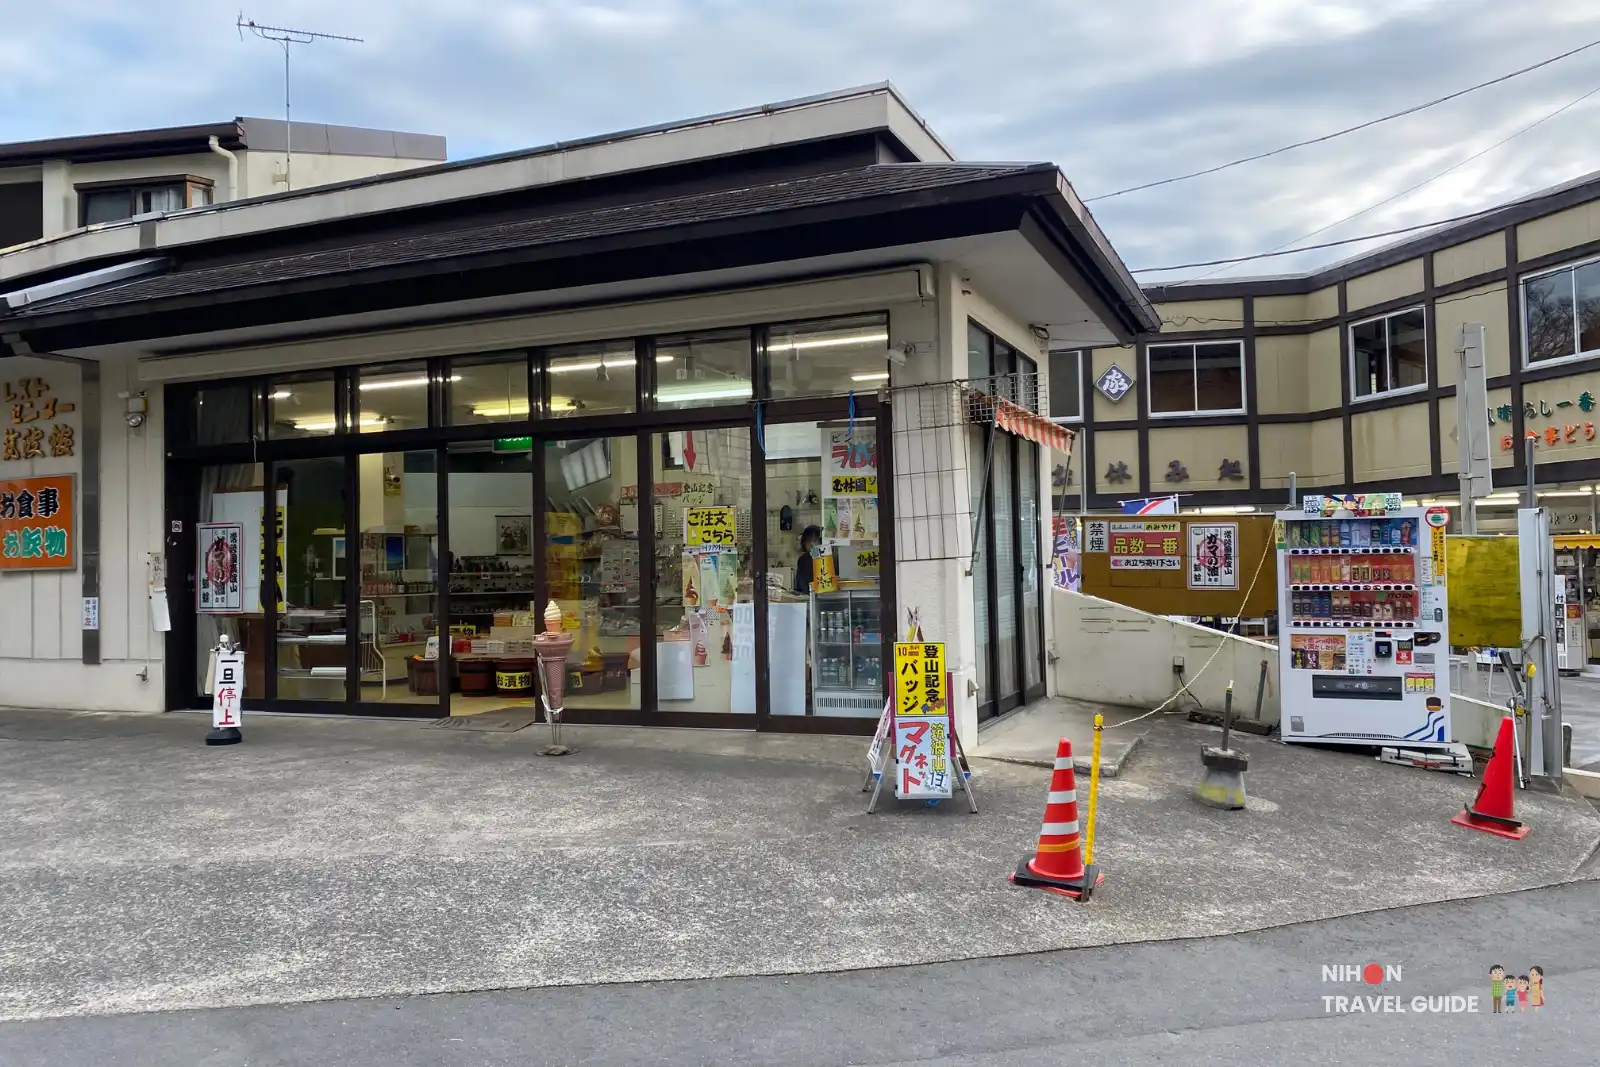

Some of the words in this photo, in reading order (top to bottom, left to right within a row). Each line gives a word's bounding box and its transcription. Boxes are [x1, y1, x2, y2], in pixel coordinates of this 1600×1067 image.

[4, 378, 49, 402] レスト
[11, 398, 75, 424] センター
[0, 487, 59, 519] お食事
[3, 526, 67, 558] お飲物
[702, 529, 734, 543] こちら
[1089, 522, 1105, 551] 禁煙
[1113, 536, 1178, 555] 品数一番
[1124, 559, 1180, 567] お立ち寄り下さい
[497, 674, 530, 688] お漬物
[901, 659, 919, 713] バッジ
[924, 645, 940, 702] 登山記念
[899, 722, 930, 794] マグネット
[931, 723, 946, 771] 筑波山
